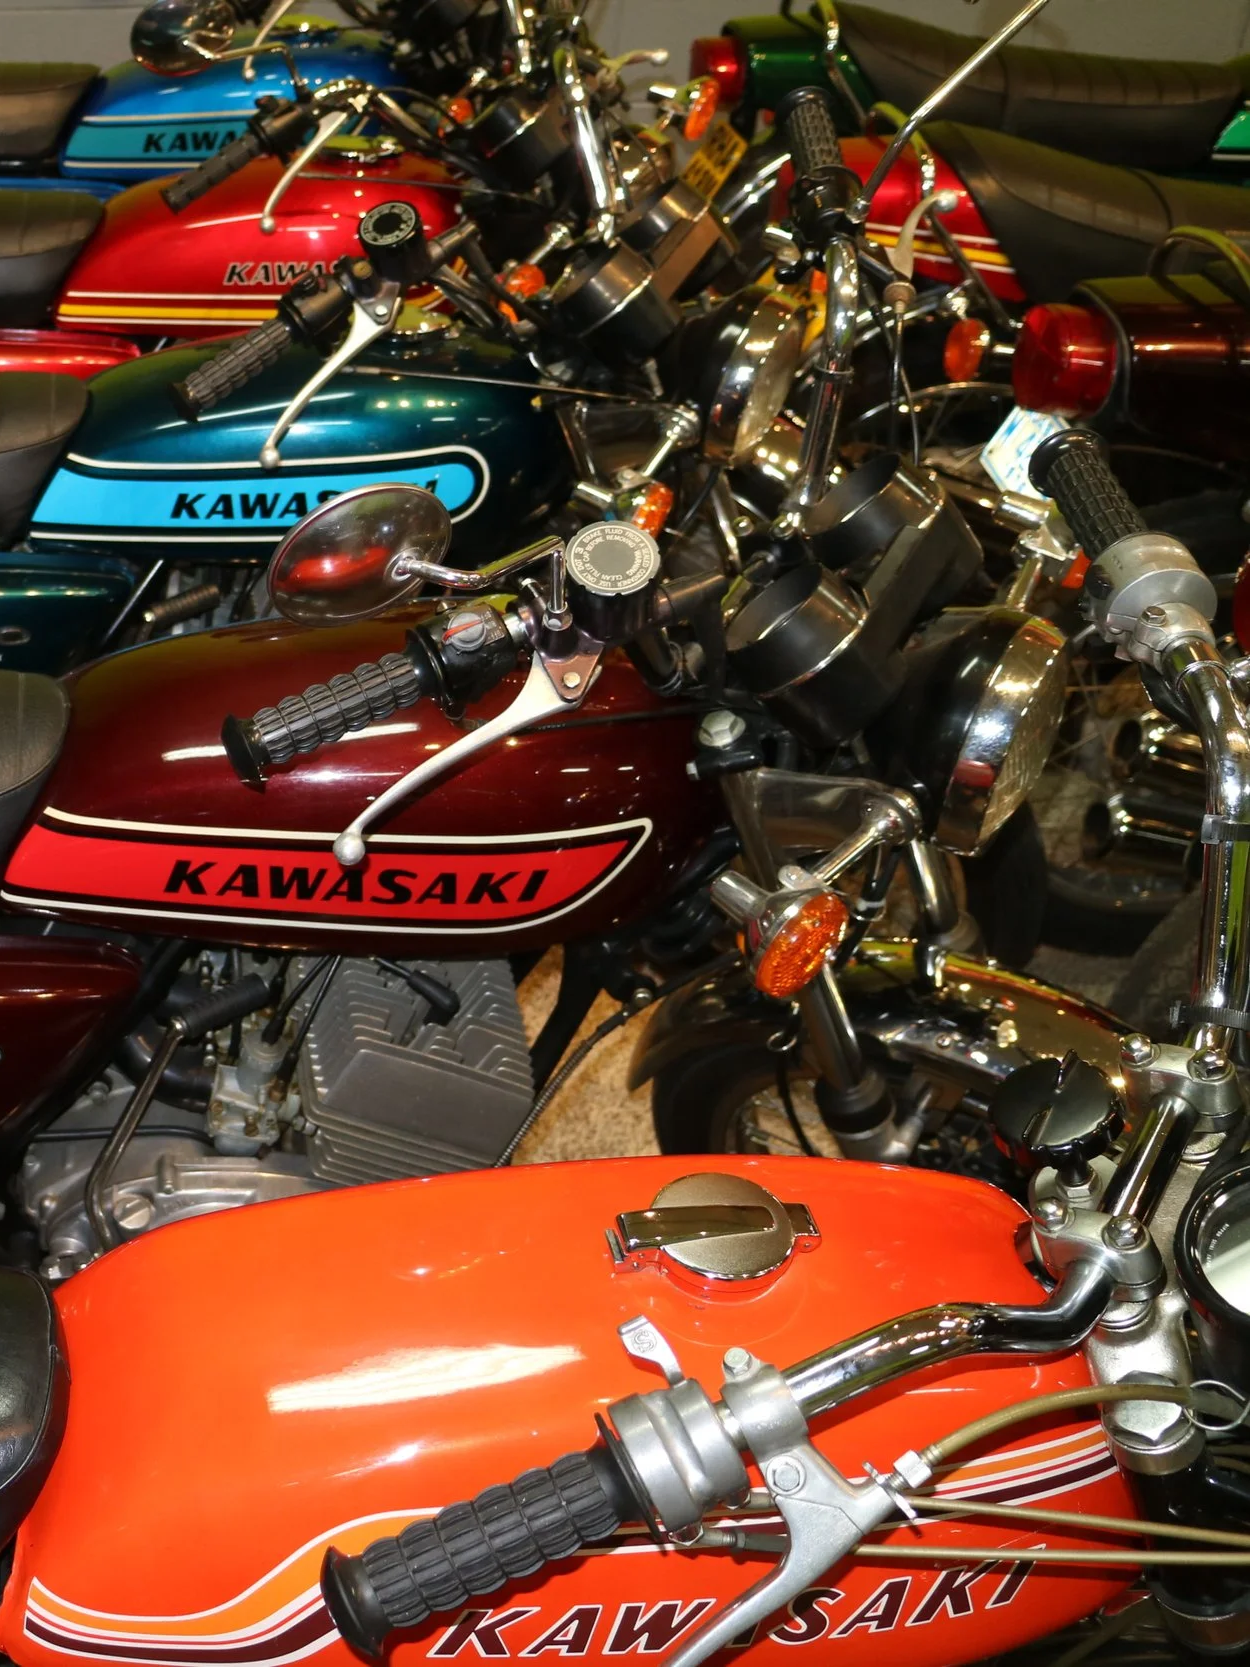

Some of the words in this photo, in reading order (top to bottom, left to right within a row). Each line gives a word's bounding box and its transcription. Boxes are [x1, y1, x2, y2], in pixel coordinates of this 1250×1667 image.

[223, 261, 338, 286] KAWA
[582, 530, 602, 543] BRAKE
[585, 536, 605, 551] BEFORE
[606, 534, 636, 548] REMOVING
[624, 531, 641, 543] FROM
[575, 559, 584, 571] DOT
[584, 563, 601, 578] FILLER
[582, 572, 597, 583] ONLY
[163, 859, 549, 905] KAWASAKI
[427, 1543, 1047, 1658] KAWSAKI
